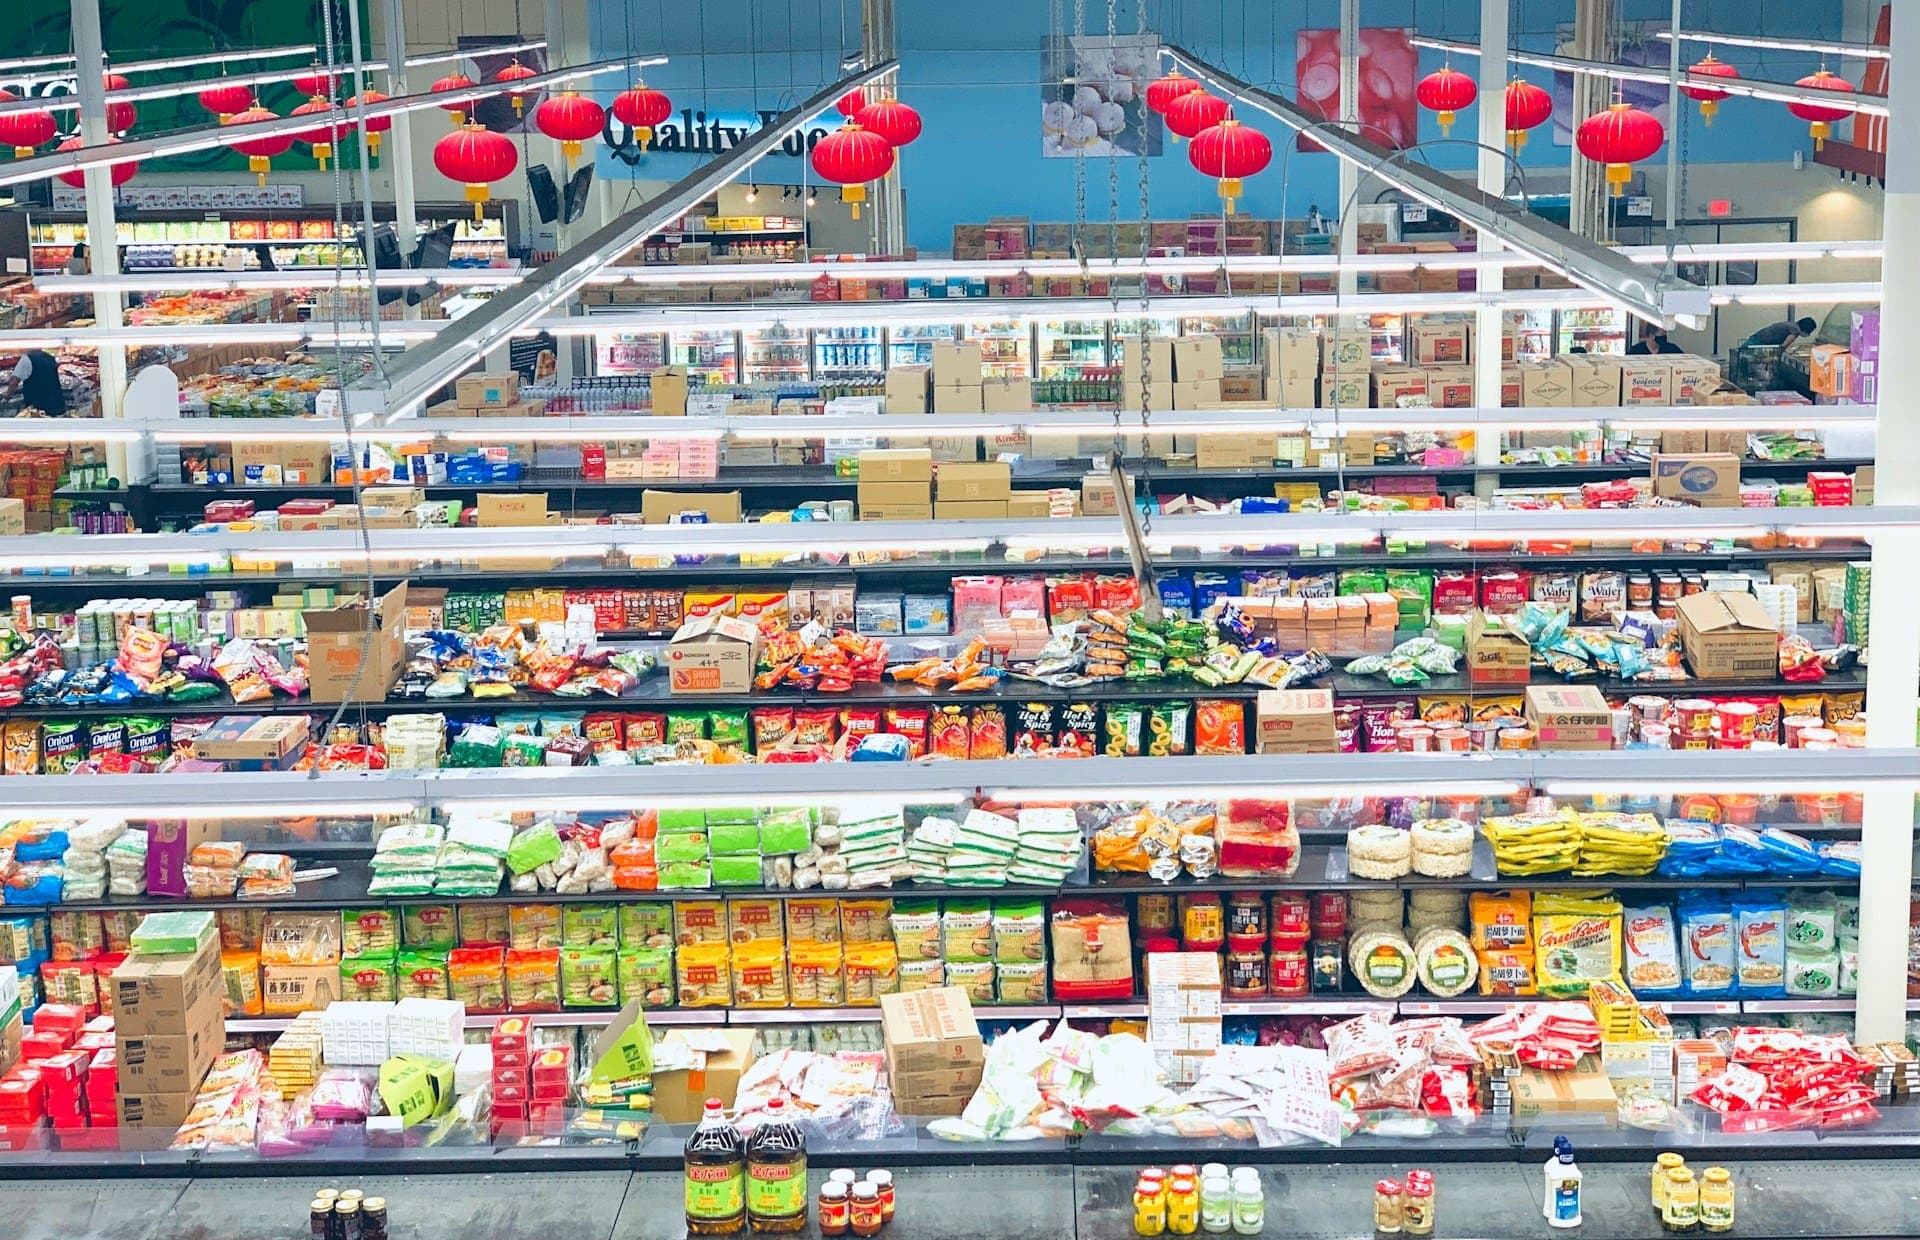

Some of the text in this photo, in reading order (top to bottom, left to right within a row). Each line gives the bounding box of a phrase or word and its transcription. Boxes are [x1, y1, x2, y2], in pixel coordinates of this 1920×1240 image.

[1631, 376, 1662, 387] Seafood
[1539, 586, 1572, 598] Wafer
[1588, 586, 1622, 598] Wafer
[1018, 710, 1039, 722] Hot
[1062, 710, 1082, 721] Hot
[1025, 720, 1053, 731] Spicy
[1067, 719, 1097, 731] Spicy
[47, 735, 74, 748] Onion
[93, 730, 121, 745] Onion
[129, 735, 156, 750] Onion
[1539, 931, 1574, 948] Green
[1575, 919, 1611, 938] Beans
[954, 1045, 963, 1056] 9
[955, 1071, 964, 1081] 7
